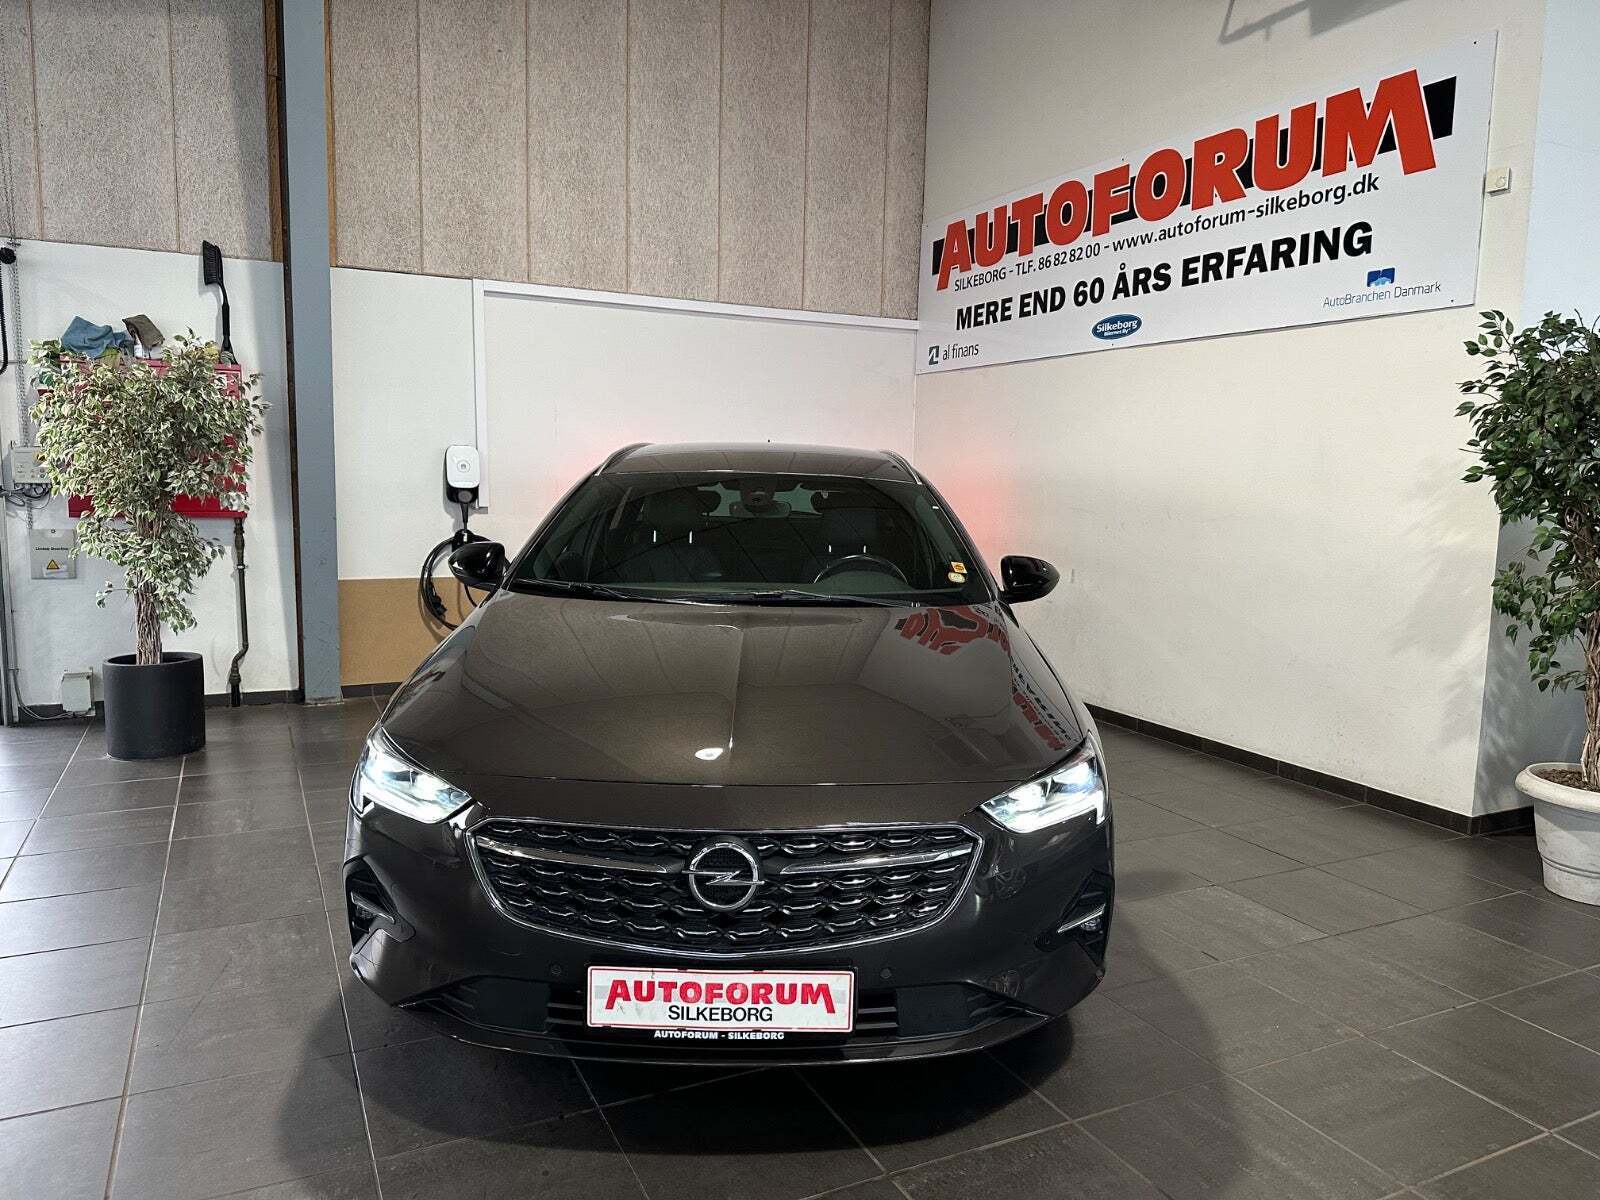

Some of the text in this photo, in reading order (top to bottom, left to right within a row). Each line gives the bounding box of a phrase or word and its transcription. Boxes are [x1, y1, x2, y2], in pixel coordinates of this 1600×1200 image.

[936, 69, 1436, 291] AUTOFORUM
[954, 267, 1006, 292] SILKEBORG
[1015, 259, 1036, 276] TLF.
[1112, 172, 1380, 252] www.autoforum-silkeborg.dk
[956, 221, 1374, 331] MERE END 60 ÅRS ERFARING
[1323, 281, 1441, 308] AutoBranchen Danmark
[1096, 319, 1138, 333] Silkeborg
[951, 343, 979, 359] finans
[605, 979, 836, 1014] AUTOFORUM
[668, 1005, 773, 1022] SILKEBORG
[654, 1030, 718, 1040] AUTOFORUM
[728, 1031, 785, 1040] SILKEBORG
